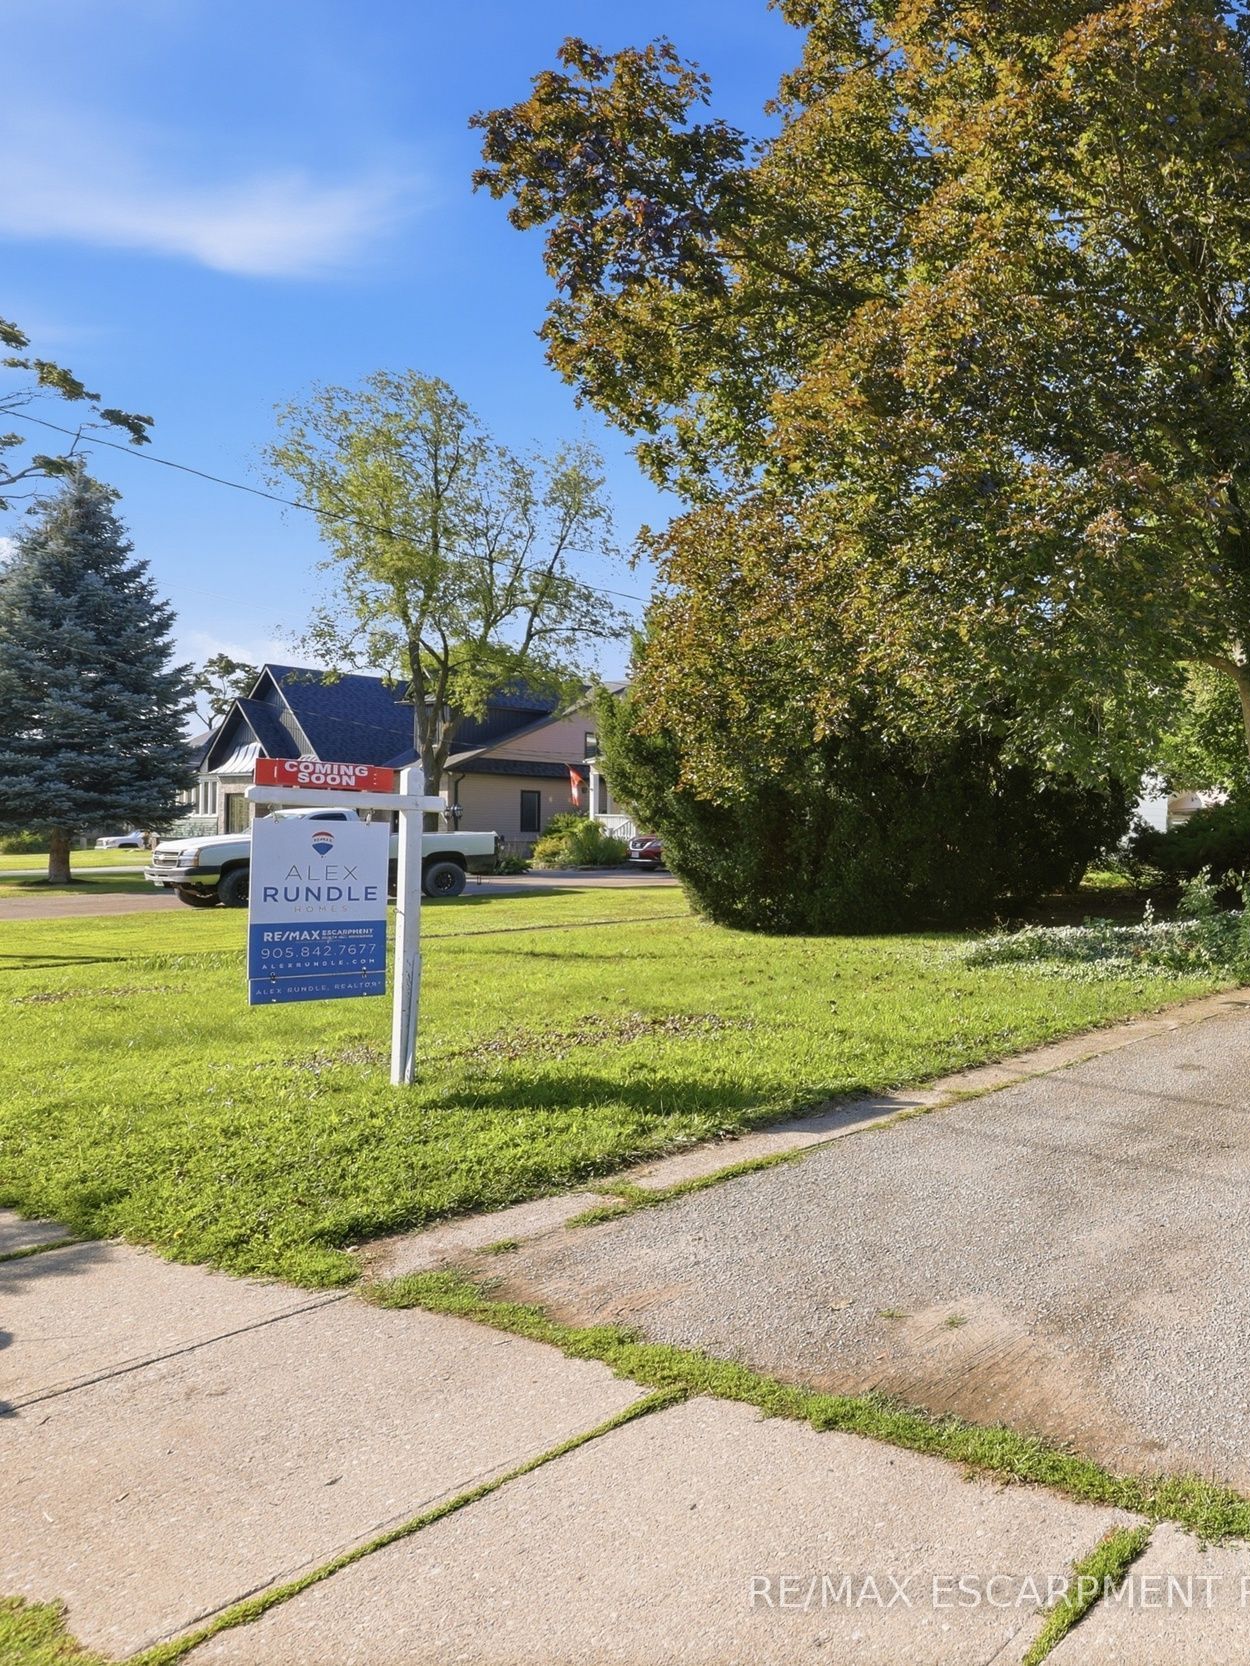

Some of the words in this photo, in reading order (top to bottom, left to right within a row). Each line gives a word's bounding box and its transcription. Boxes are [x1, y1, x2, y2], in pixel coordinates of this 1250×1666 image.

[284, 761, 369, 777] COMING
[297, 773, 356, 786] SOON
[284, 865, 358, 881] ALEX
[263, 886, 378, 903] RUNDLE
[294, 905, 349, 913] HOMES
[263, 930, 320, 942] RE/MAX
[260, 943, 377, 960] 905.842.7677
[261, 959, 375, 970] ALEXRUNDLE.COM
[255, 988, 282, 996] ALEX
